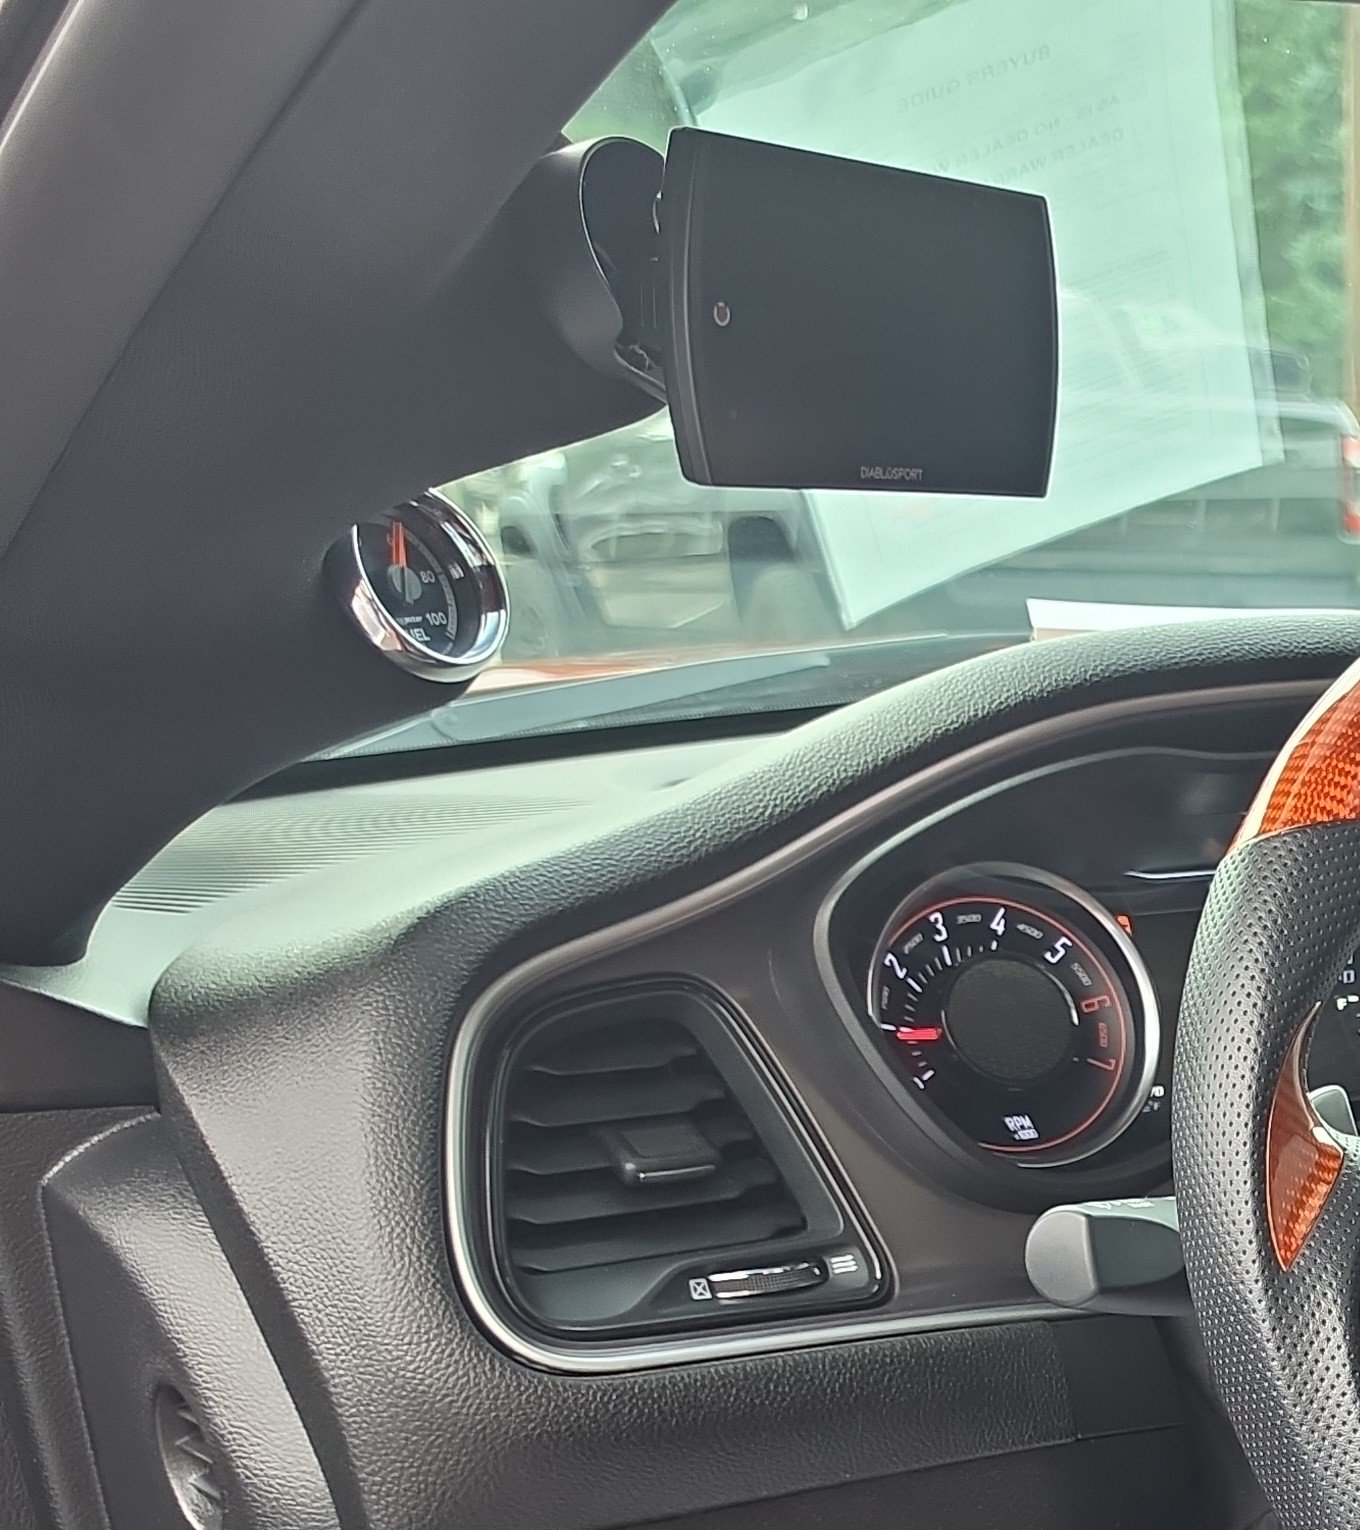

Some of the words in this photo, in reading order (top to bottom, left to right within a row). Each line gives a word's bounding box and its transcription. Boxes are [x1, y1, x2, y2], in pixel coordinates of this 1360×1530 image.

[420, 570, 436, 584] 80
[425, 611, 448, 626] 100
[928, 911, 949, 942] 3
[989, 907, 1006, 936] 4
[1043, 936, 1073, 964] 5
[884, 952, 908, 979] 2
[1081, 995, 1110, 1013] 6
[1003, 1114, 1035, 1132] RPM
